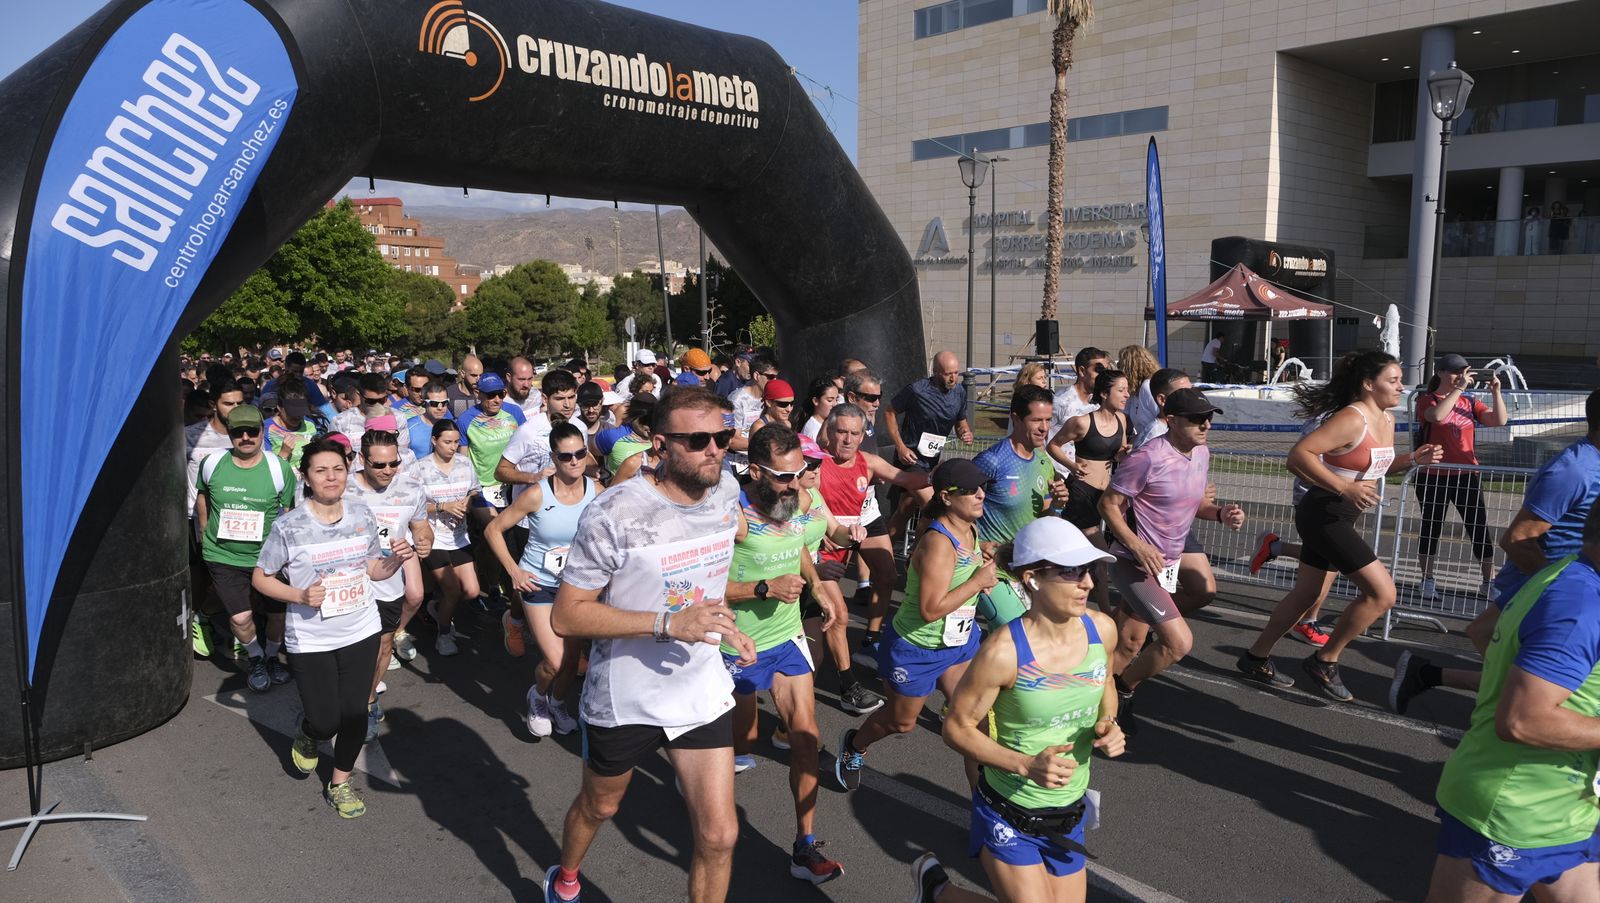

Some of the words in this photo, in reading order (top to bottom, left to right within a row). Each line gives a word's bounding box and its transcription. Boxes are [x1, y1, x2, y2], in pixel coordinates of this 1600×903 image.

[603, 93, 698, 122] cronometraje
[700, 109, 759, 130] deportivo
[164, 98, 288, 288] centrohogarsanchez.es
[928, 441, 939, 450] 64
[224, 519, 257, 531] 1211
[327, 584, 365, 603] 1064
